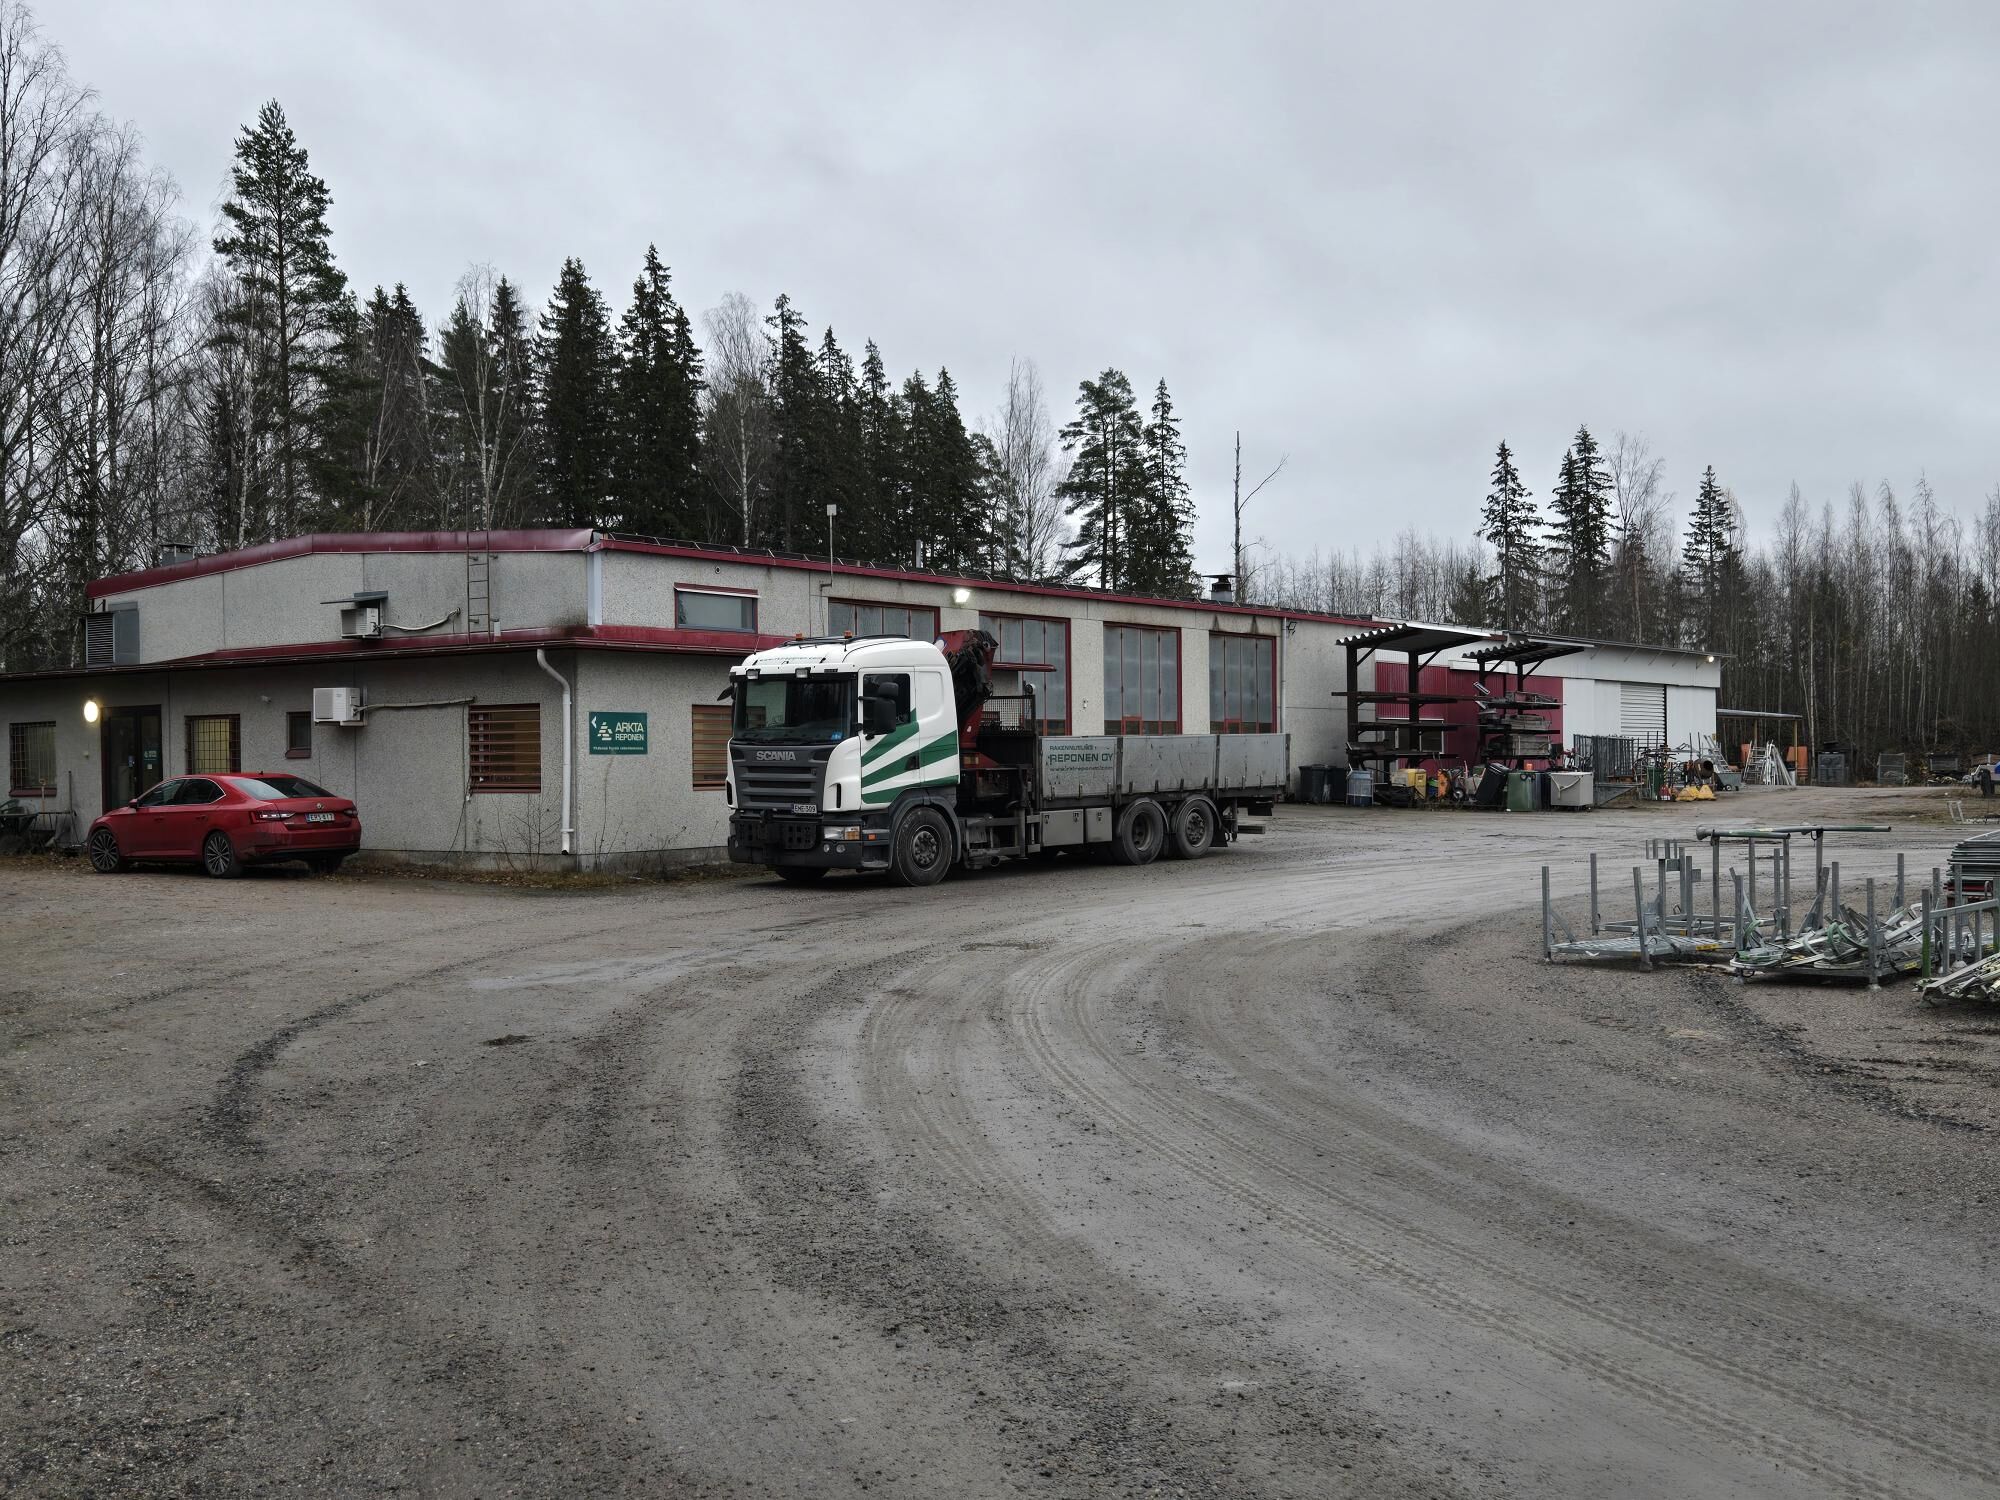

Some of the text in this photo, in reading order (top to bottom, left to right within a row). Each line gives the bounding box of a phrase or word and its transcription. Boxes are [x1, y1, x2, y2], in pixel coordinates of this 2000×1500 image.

[615, 722, 644, 732] ARKTA
[756, 751, 796, 760] SCANIA
[1049, 753, 1113, 762] REPONEN OY
